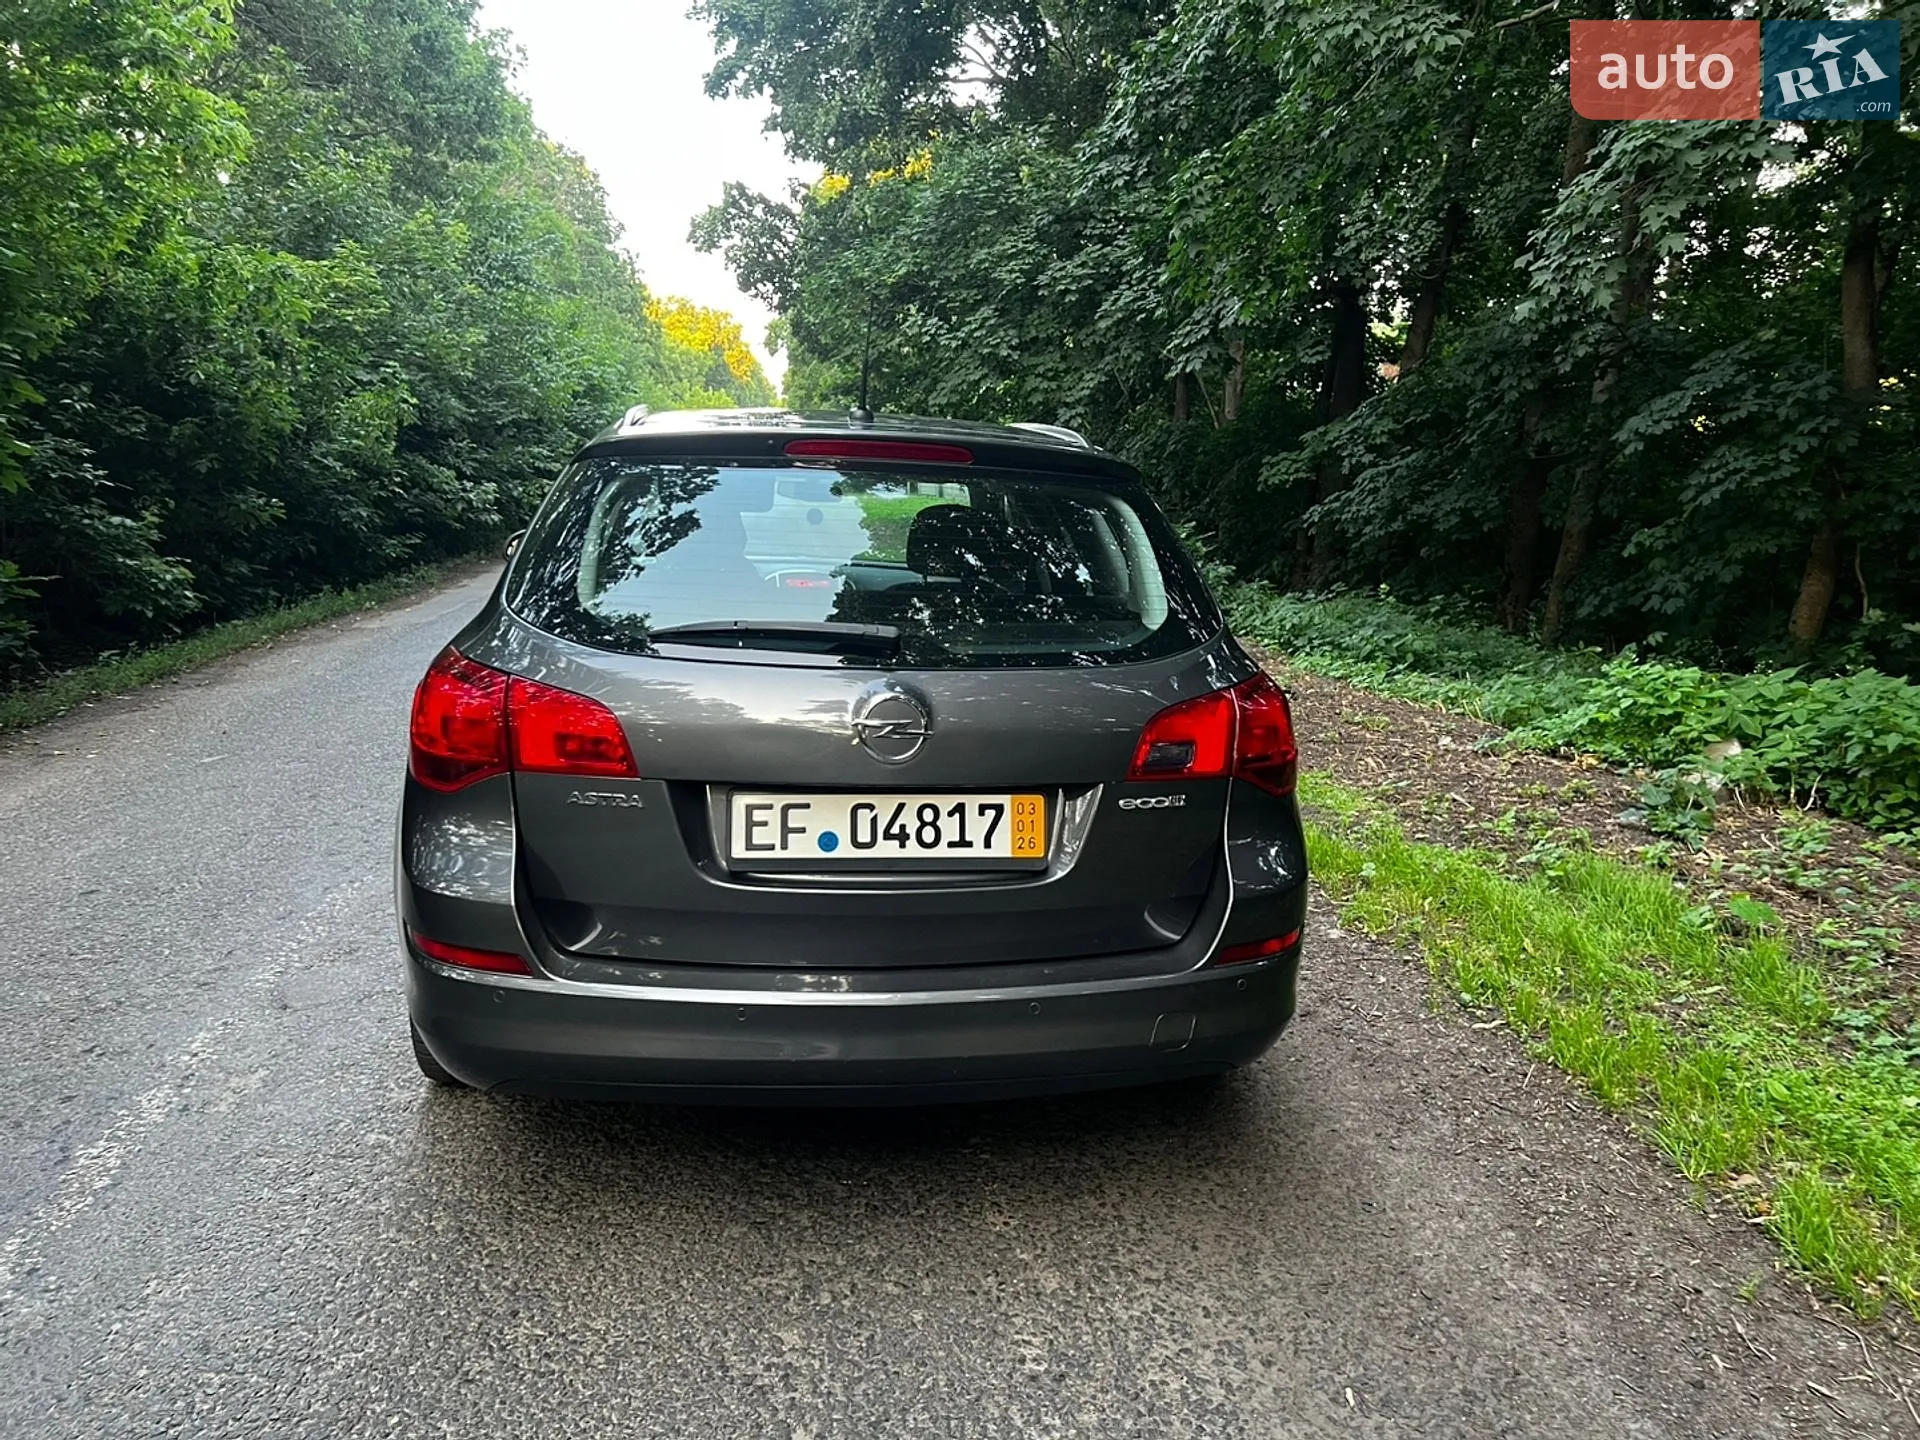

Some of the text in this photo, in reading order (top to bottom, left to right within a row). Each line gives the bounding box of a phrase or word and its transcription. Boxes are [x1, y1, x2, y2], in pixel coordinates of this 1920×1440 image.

[567, 791, 644, 807] ASTRA
[1017, 803, 1036, 816] 03
[744, 802, 1005, 851] EF 04817
[1017, 820, 1036, 833] 01
[1017, 836, 1036, 850] 26
